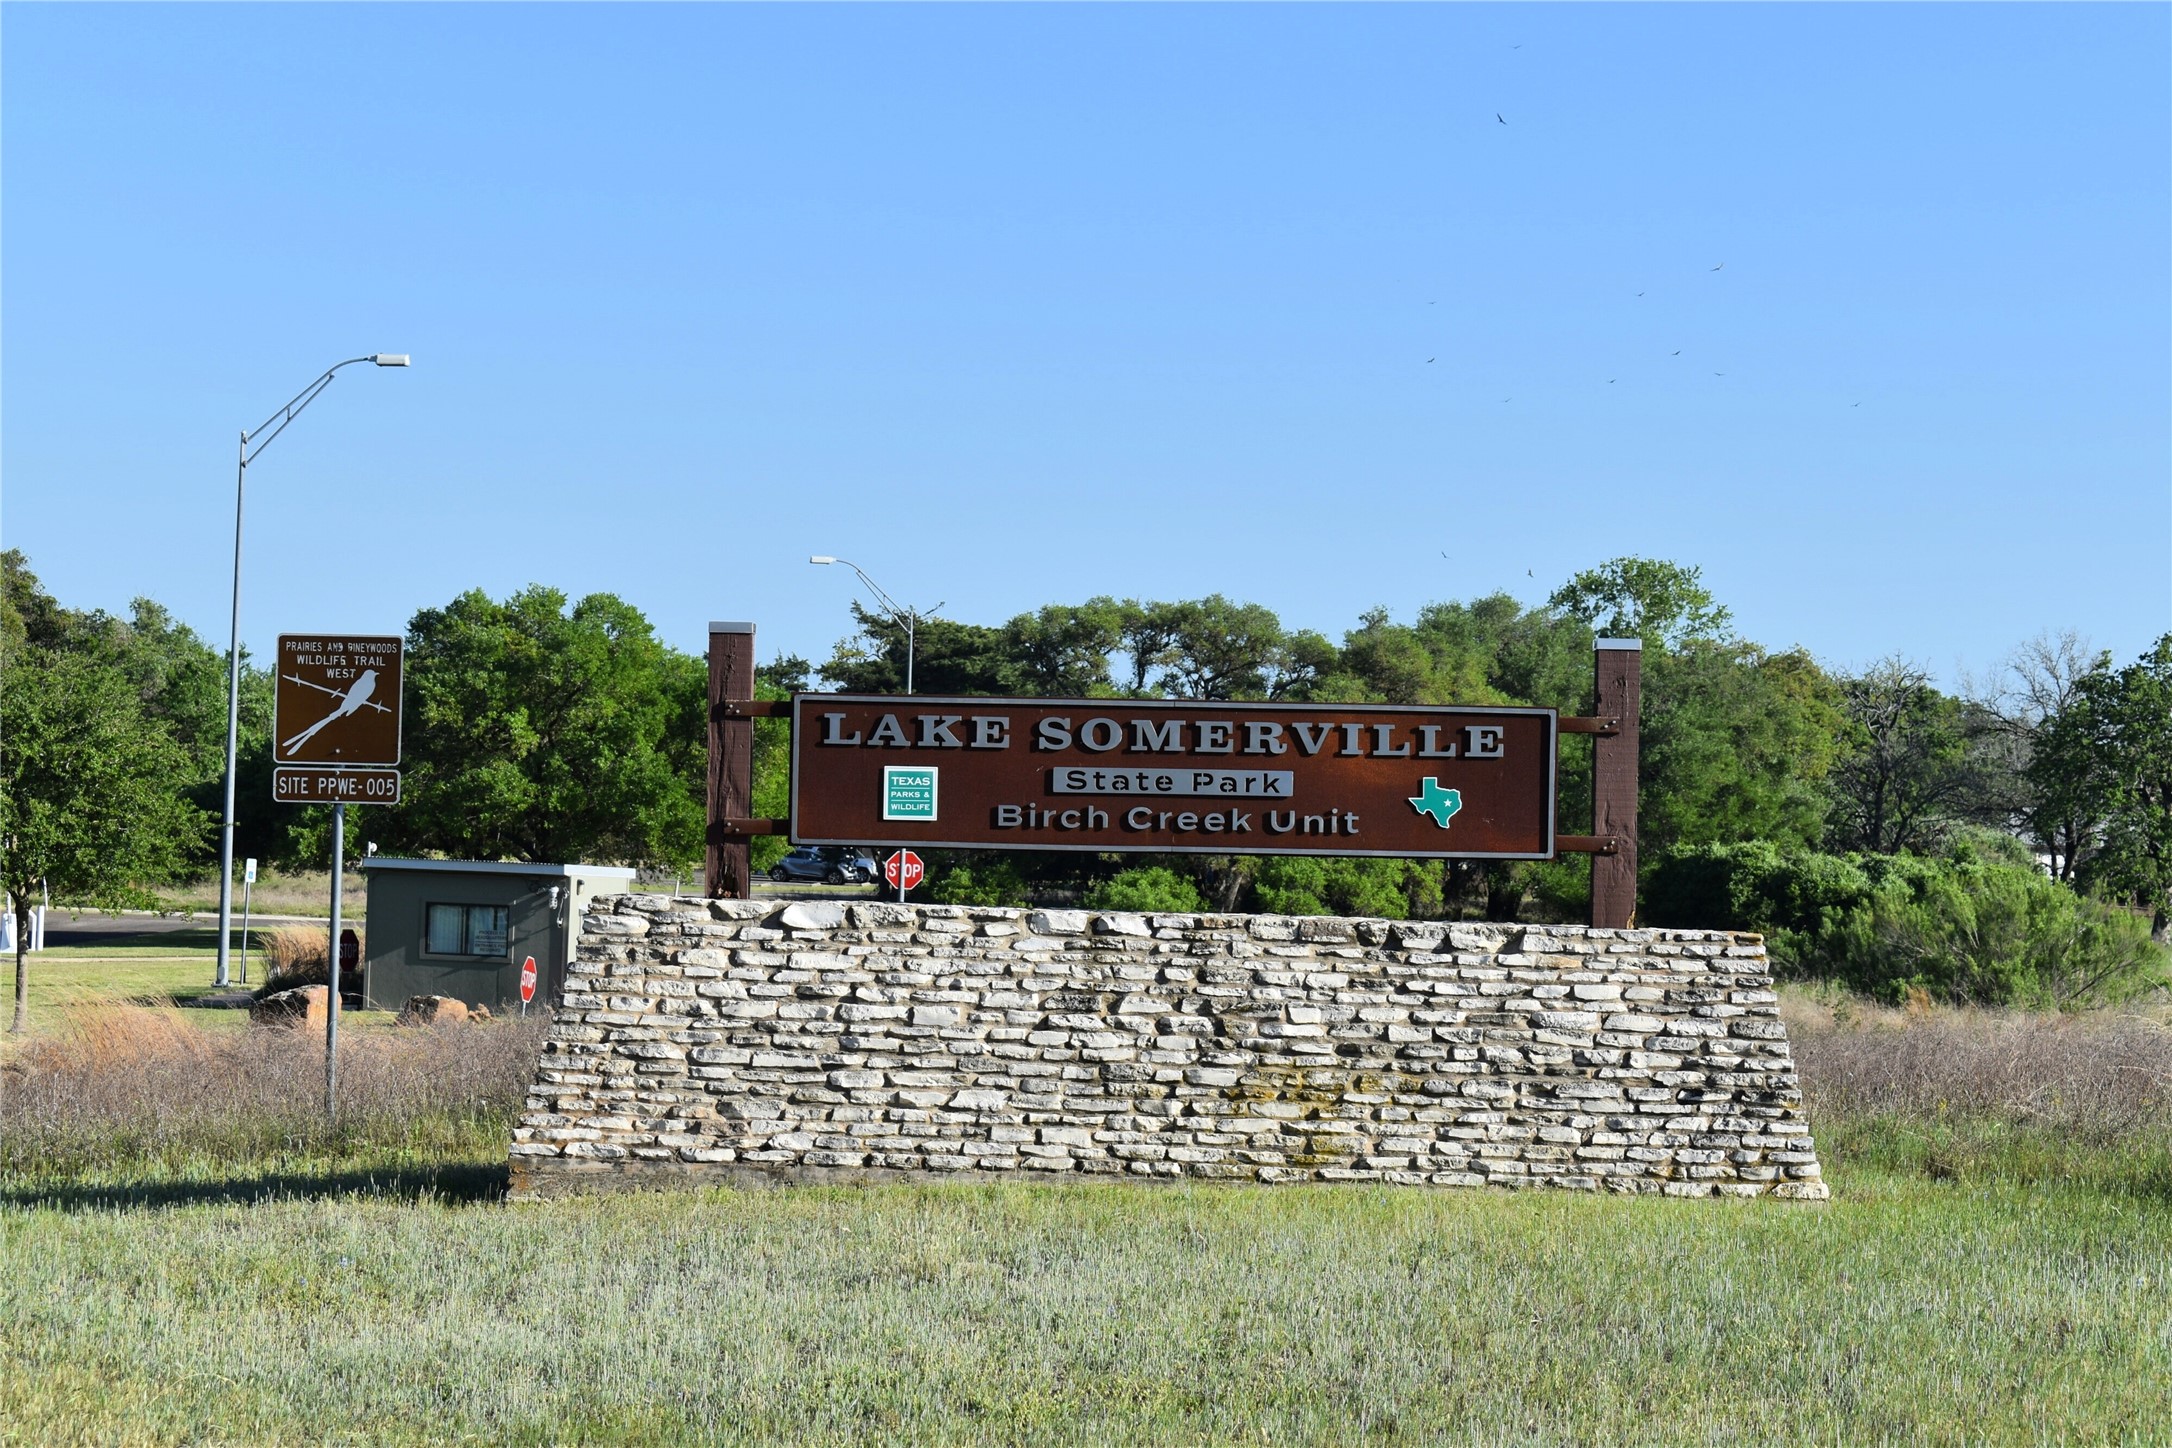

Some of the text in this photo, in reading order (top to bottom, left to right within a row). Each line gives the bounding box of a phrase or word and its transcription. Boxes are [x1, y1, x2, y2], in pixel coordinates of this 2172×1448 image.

[286, 641, 397, 654] PRAIRIES AND PINEYWOODS
[296, 654, 386, 666] WILDLIFE TRAIL
[326, 668, 356, 679] WEST
[823, 712, 1505, 758] LAKE SOMERVILLE
[278, 776, 395, 796] SITE PPWE-005
[891, 776, 930, 786] TEXAS
[1066, 769, 1282, 794] State Park
[890, 803, 930, 811] WILDLIFE
[997, 802, 1359, 834] Birch Creek Unit
[888, 863, 921, 878] SOP
[340, 943, 357, 959] STOP
[521, 969, 535, 989] STOP
